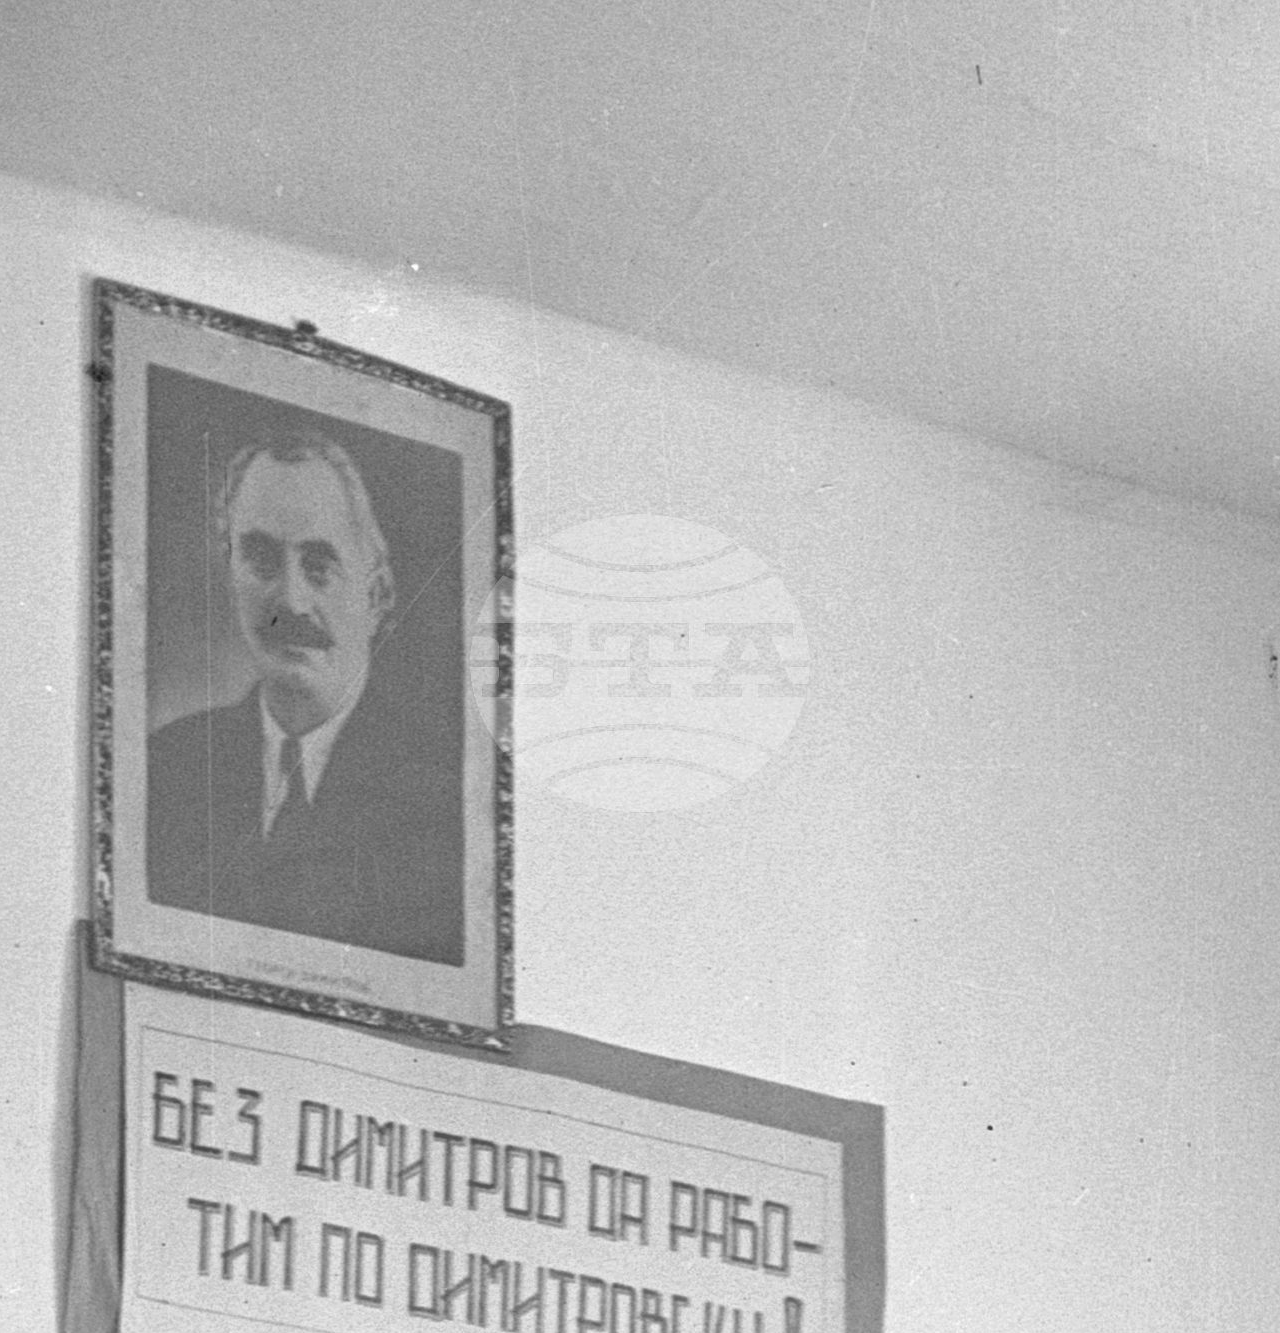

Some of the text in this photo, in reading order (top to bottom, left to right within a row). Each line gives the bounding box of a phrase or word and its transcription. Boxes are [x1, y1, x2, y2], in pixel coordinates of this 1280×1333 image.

[152, 1071, 822, 1275] БЕЗ ДИМИТРОВ ДА РАБО-
[187, 1197, 295, 1290] ТИМ
[319, 1223, 385, 1306] ПО
